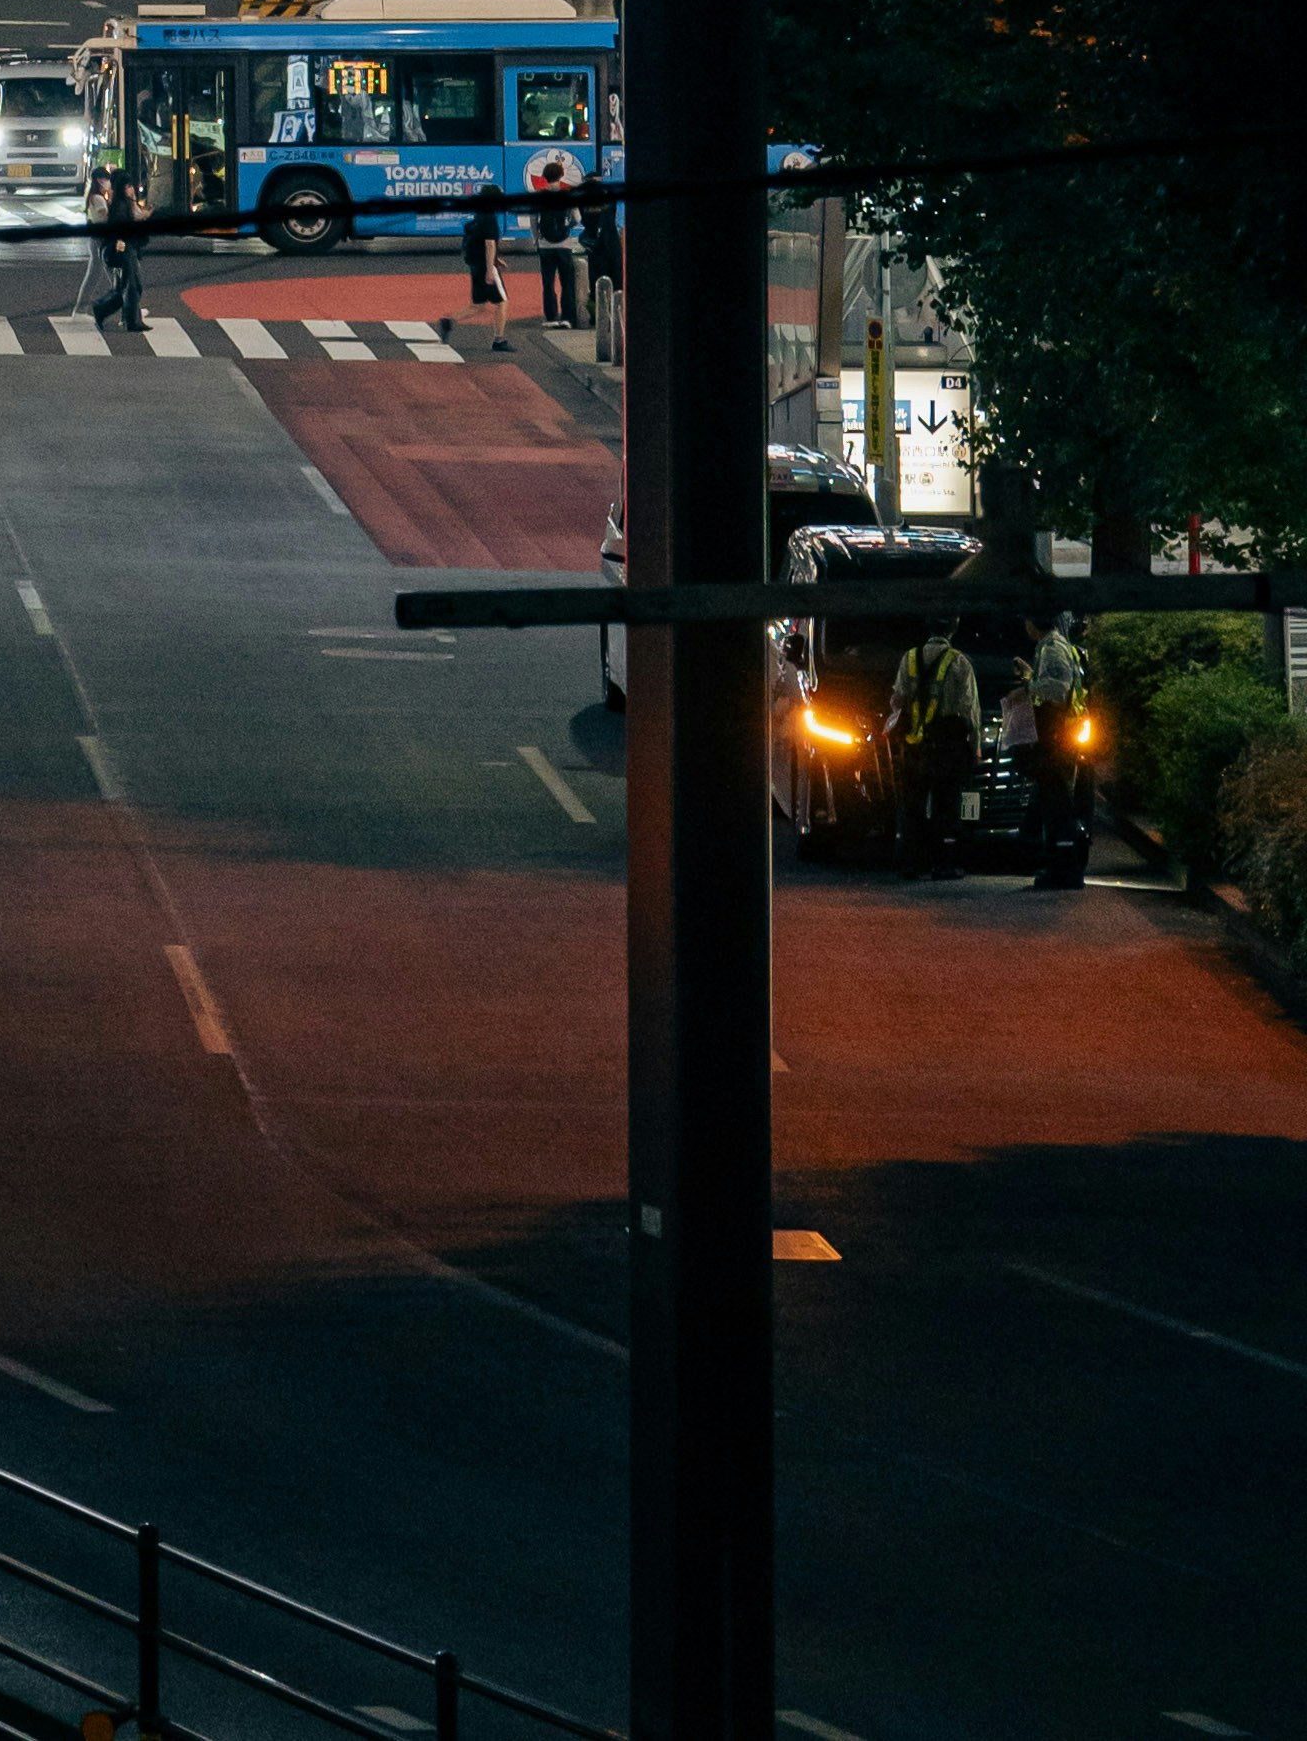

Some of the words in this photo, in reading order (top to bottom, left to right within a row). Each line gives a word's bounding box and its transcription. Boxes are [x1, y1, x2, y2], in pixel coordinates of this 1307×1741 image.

[384, 165, 494, 182] 100%ドラえもん
[945, 377, 963, 389] D4
